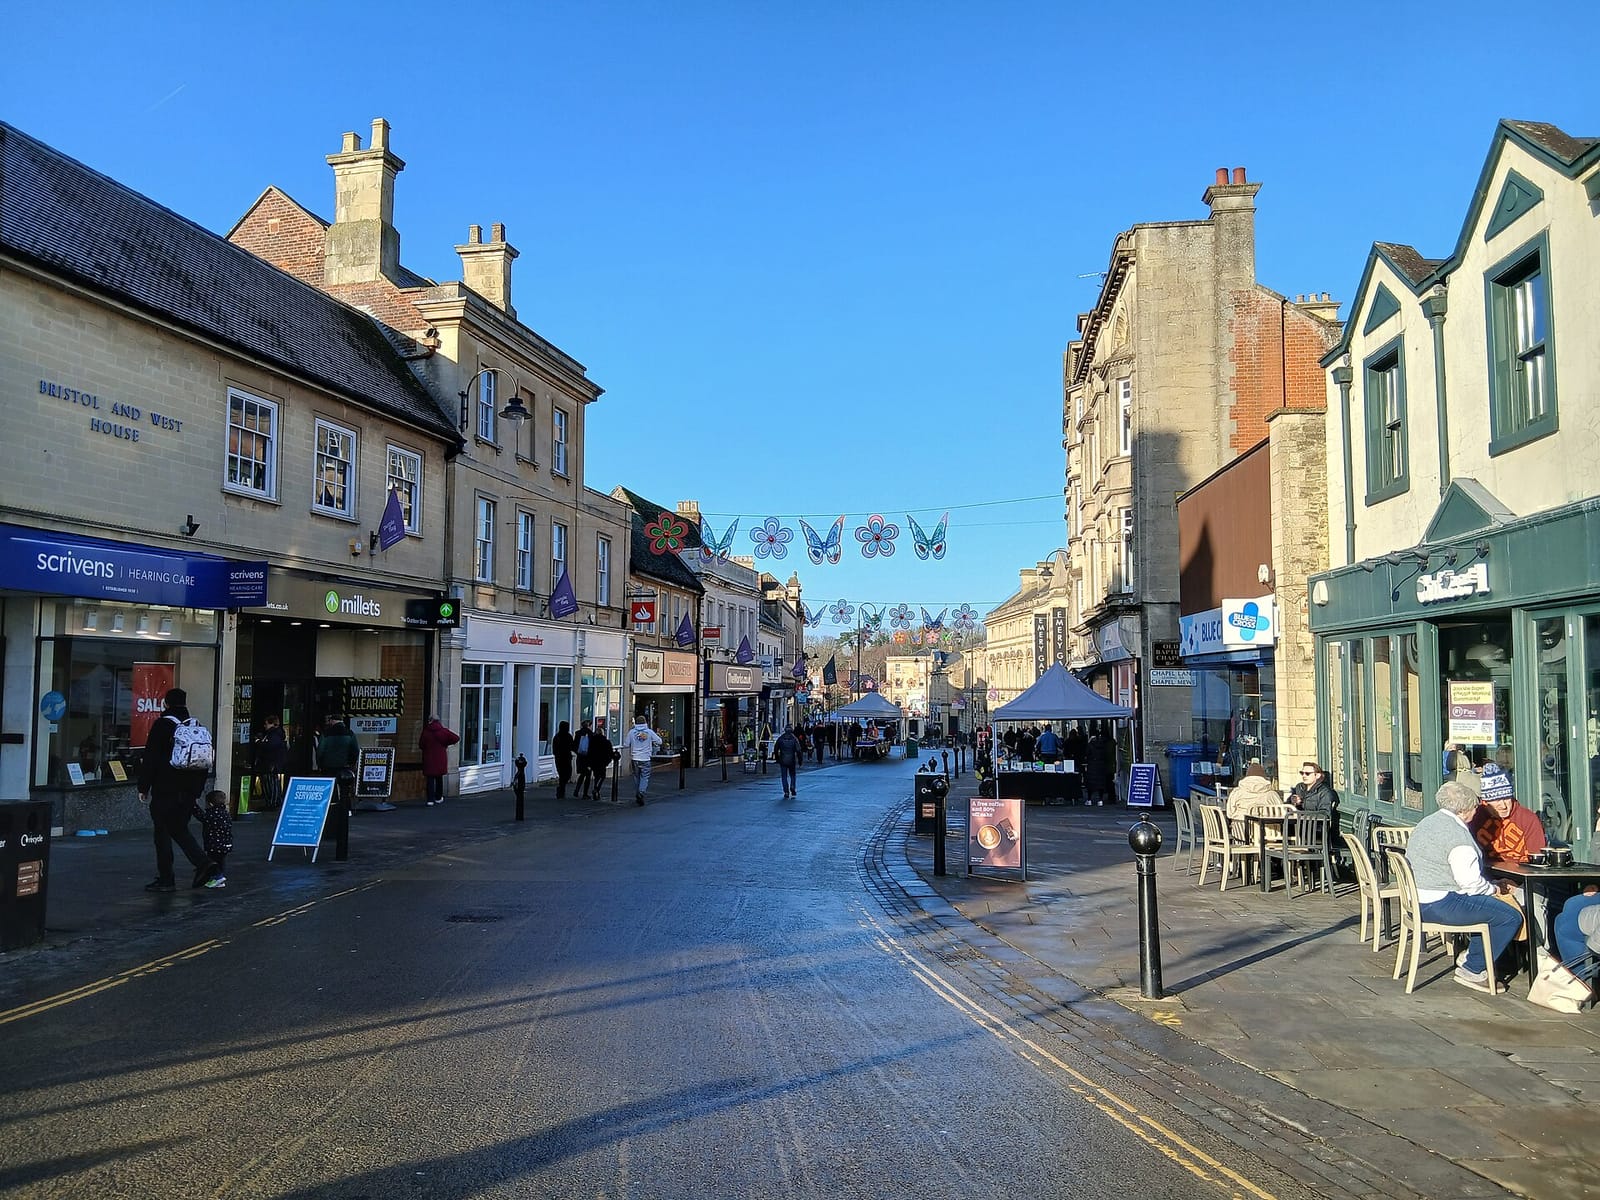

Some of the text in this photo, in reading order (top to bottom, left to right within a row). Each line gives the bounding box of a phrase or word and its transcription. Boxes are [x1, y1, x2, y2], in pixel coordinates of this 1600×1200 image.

[39, 379, 183, 434] BRISTOL AND WEST
[91, 417, 140, 442] HOUSE
[36, 550, 114, 579] scrivens
[230, 569, 264, 579] scrivens
[128, 567, 195, 587] HEARING CARE
[341, 595, 381, 617] millets
[1037, 617, 1045, 652] EMERY
[1055, 610, 1064, 649] EMERY
[1201, 620, 1216, 642] BLUE
[1232, 619, 1256, 629] CROSS
[350, 685, 399, 697] WAREHOUSE
[350, 698, 398, 710] CLEARANCE
[294, 791, 324, 801] SERVICES
